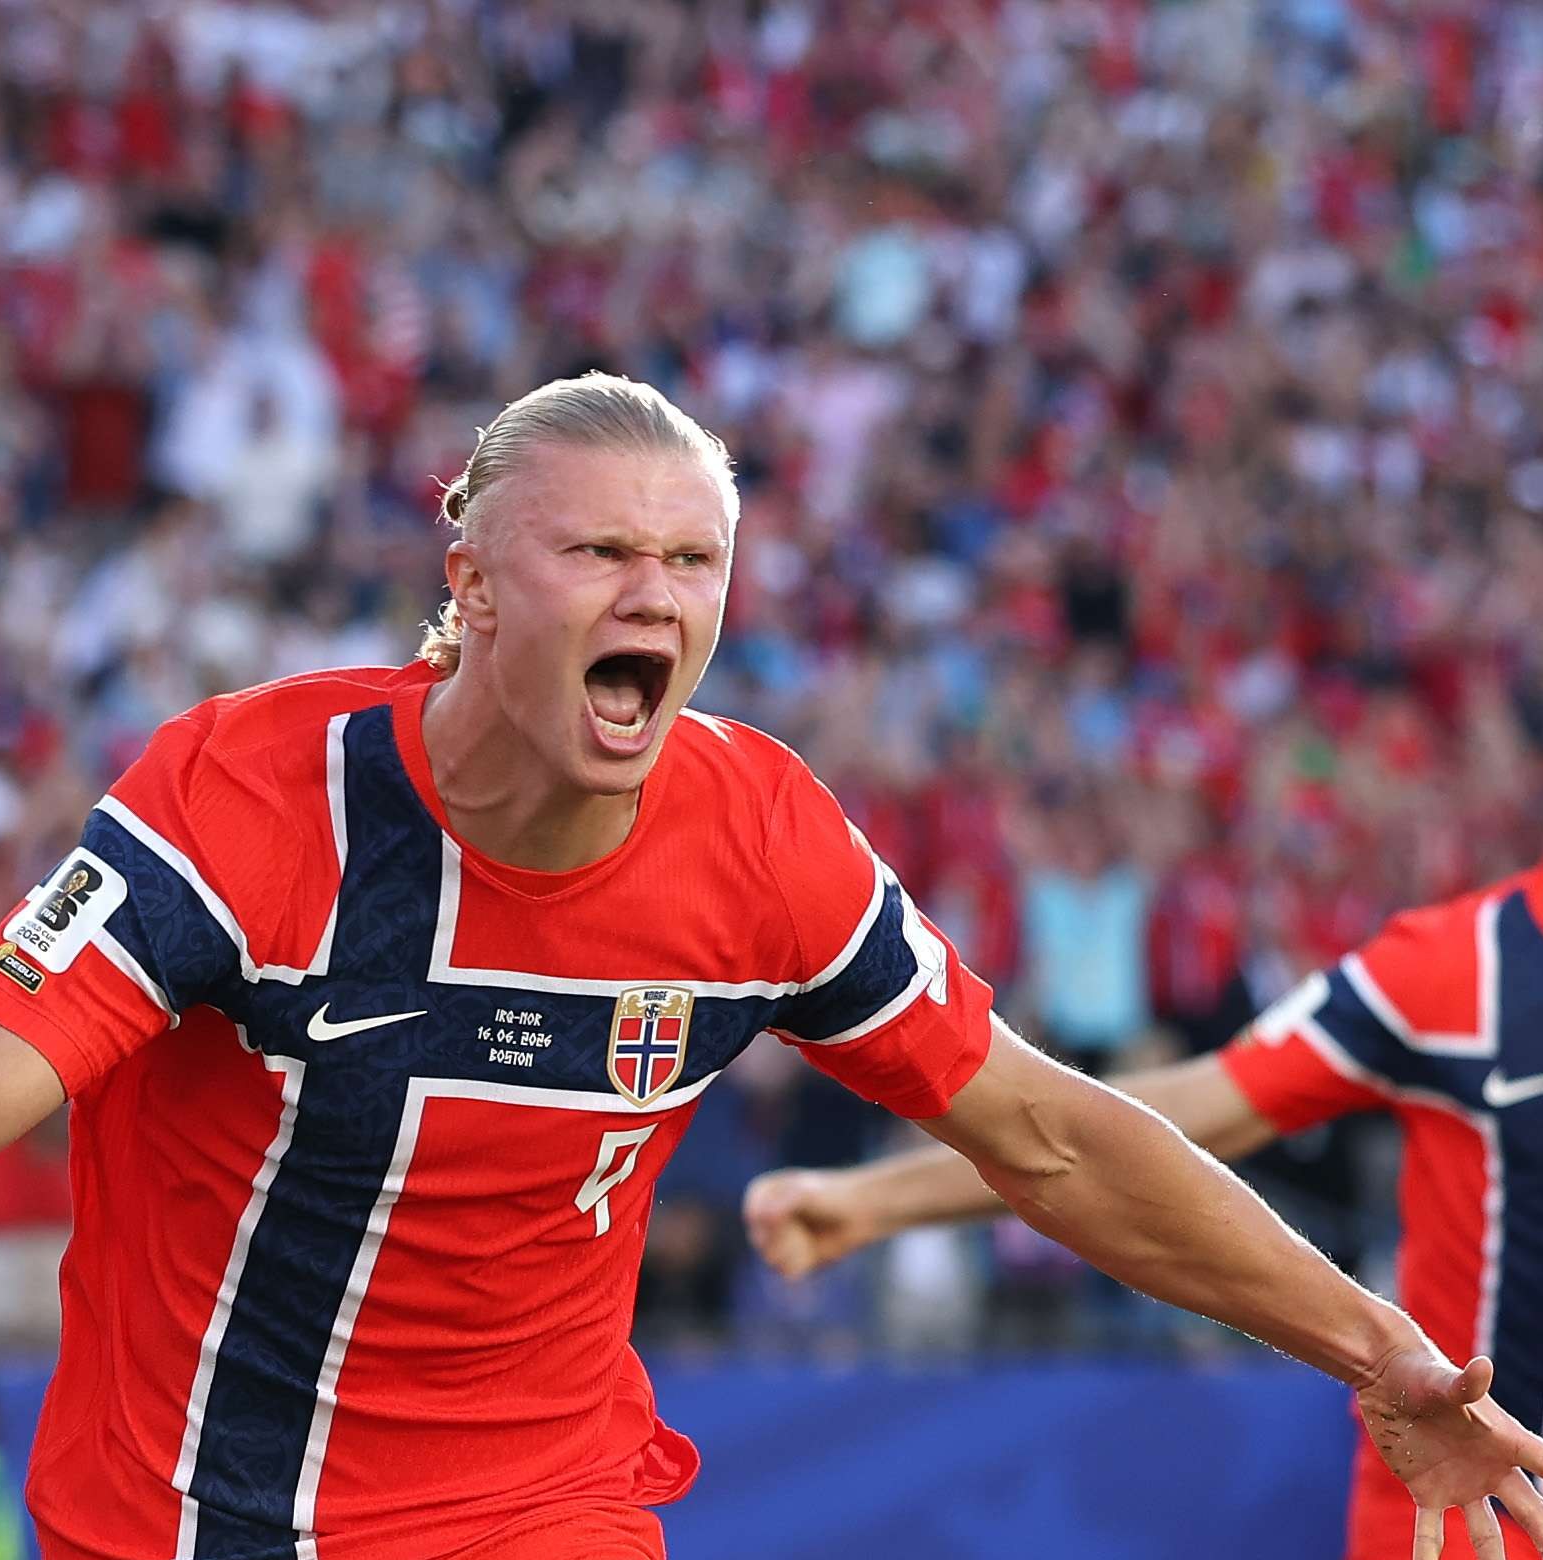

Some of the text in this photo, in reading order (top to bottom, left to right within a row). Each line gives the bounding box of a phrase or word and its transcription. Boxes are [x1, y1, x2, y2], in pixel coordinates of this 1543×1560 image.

[17, 926, 51, 953] 2026
[41, 930, 57, 943] CUP
[5, 956, 40, 982] DEBUT
[495, 1008, 543, 1026] IRQ-NOR
[520, 1031, 553, 1048] 2026
[488, 1047, 534, 1068] BOSTON
[574, 1122, 659, 1238] 9
